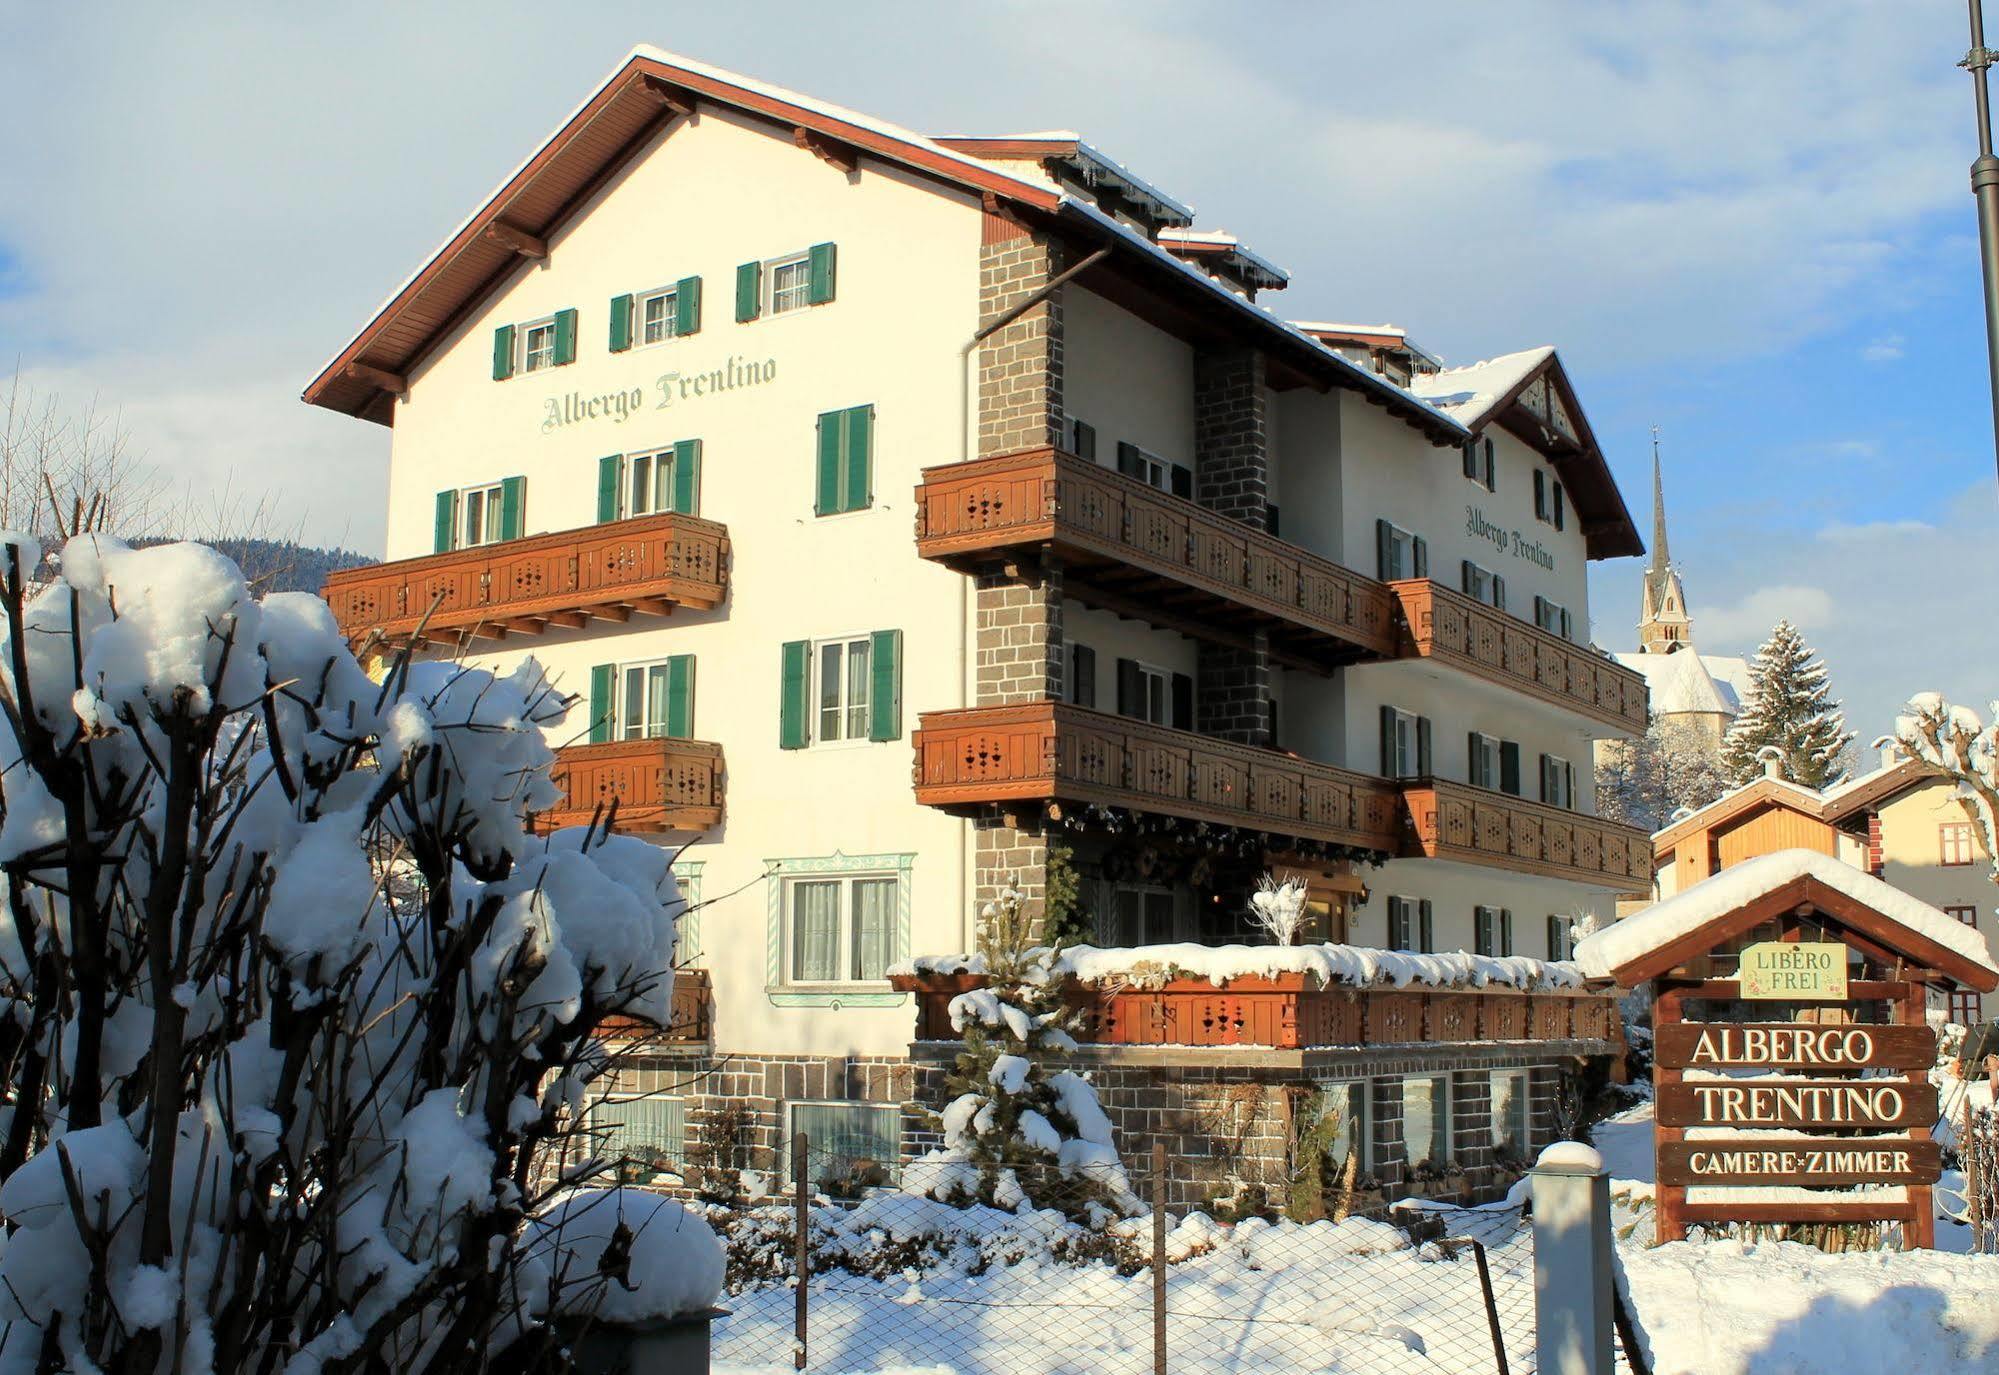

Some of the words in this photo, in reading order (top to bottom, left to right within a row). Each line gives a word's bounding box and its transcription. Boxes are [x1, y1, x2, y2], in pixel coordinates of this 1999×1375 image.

[541, 387, 642, 434] Albergo
[655, 354, 777, 410] Trentino
[1465, 505, 1508, 553] Albergo
[1511, 530, 1554, 571] Trentino
[1757, 951, 1831, 969] LIBERO
[1772, 972, 1819, 990] FREI
[1690, 1029, 1873, 1064] ALBERGO
[1694, 1086, 1903, 1122] TRENTINO
